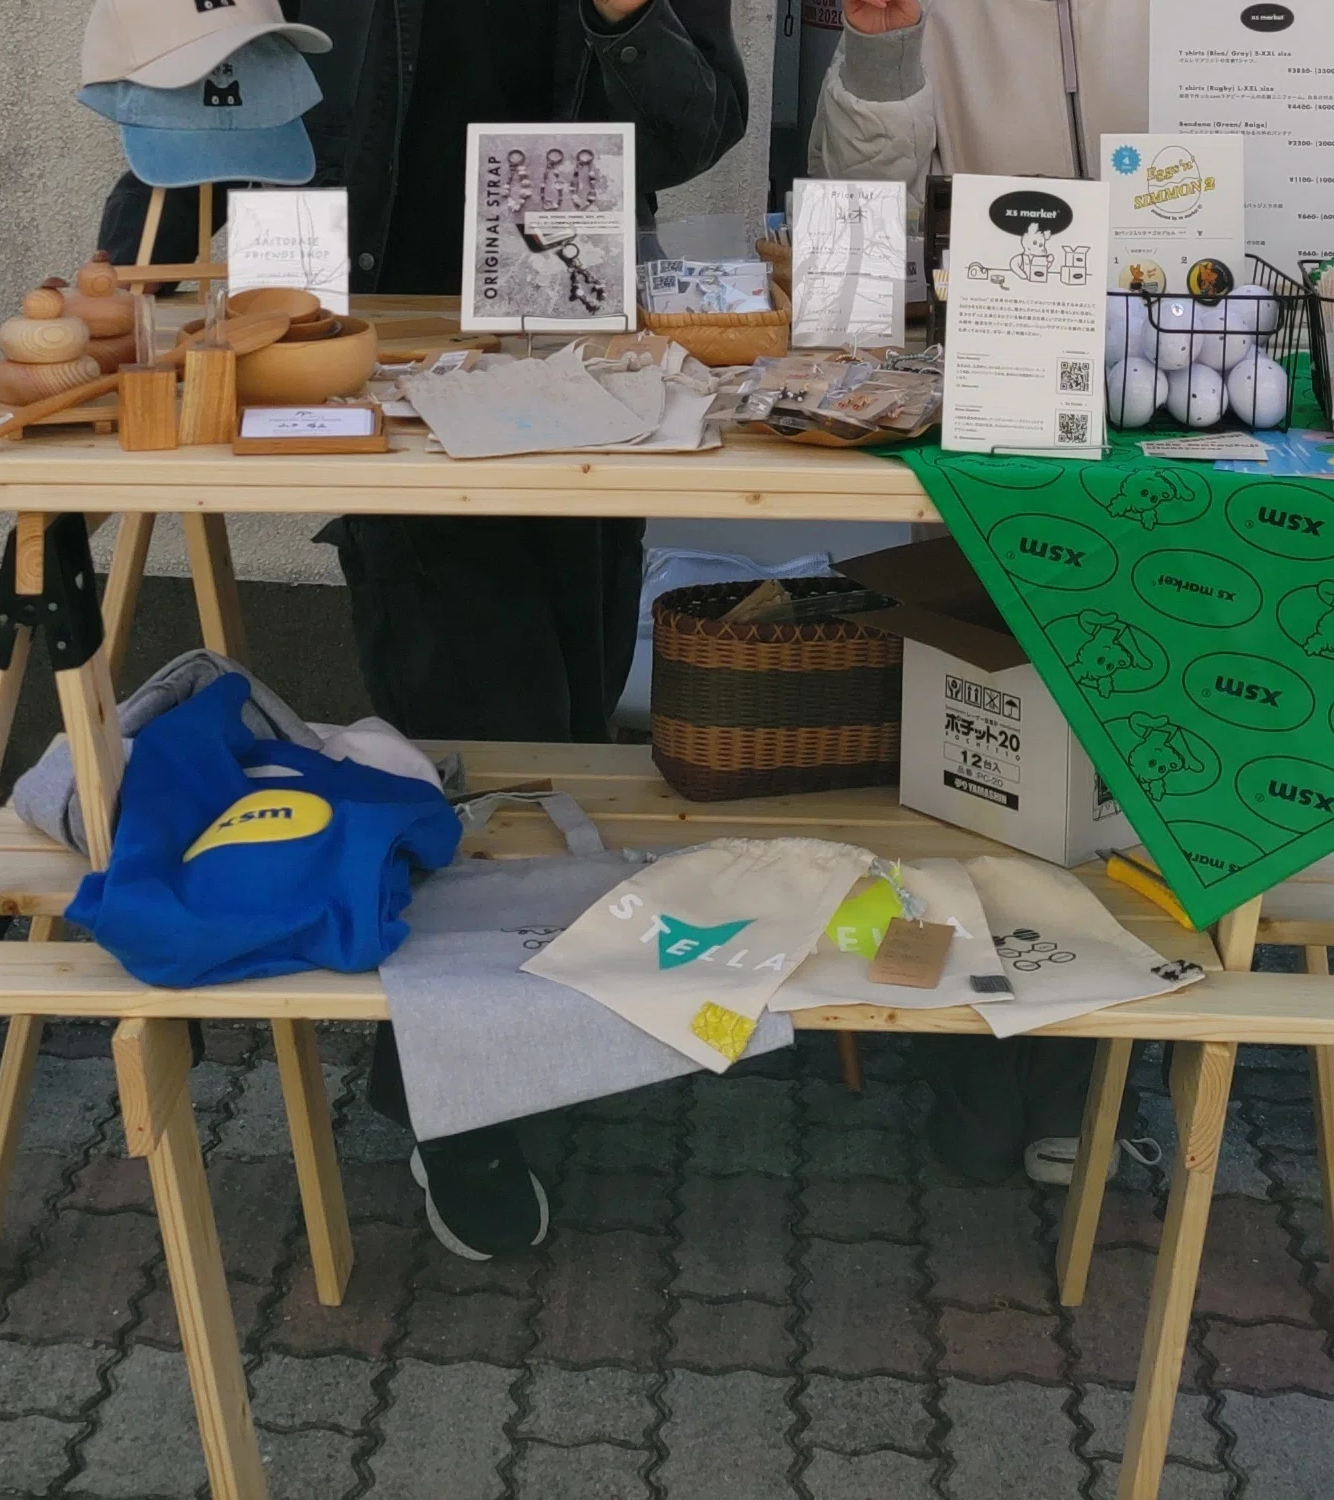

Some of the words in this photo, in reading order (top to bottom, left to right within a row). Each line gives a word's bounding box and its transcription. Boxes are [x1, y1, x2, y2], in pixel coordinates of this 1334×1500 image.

[487, 156, 502, 207] STRAP
[1204, 176, 1216, 191] 2
[1005, 208, 1018, 217] xs
[1020, 209, 1057, 219] market
[484, 214, 500, 299] ORIGINAL
[1181, 256, 1188, 264] 2
[1258, 506, 1326, 537] xsm
[1019, 536, 1087, 568] xsm
[1158, 574, 1214, 599] market
[1216, 586, 1237, 602] xs
[1215, 675, 1283, 708] xsm
[945, 712, 1021, 752] ポチット20
[960, 749, 1002, 775] 12台入
[216, 806, 293, 832] xsm
[609, 893, 786, 971] STELLA
